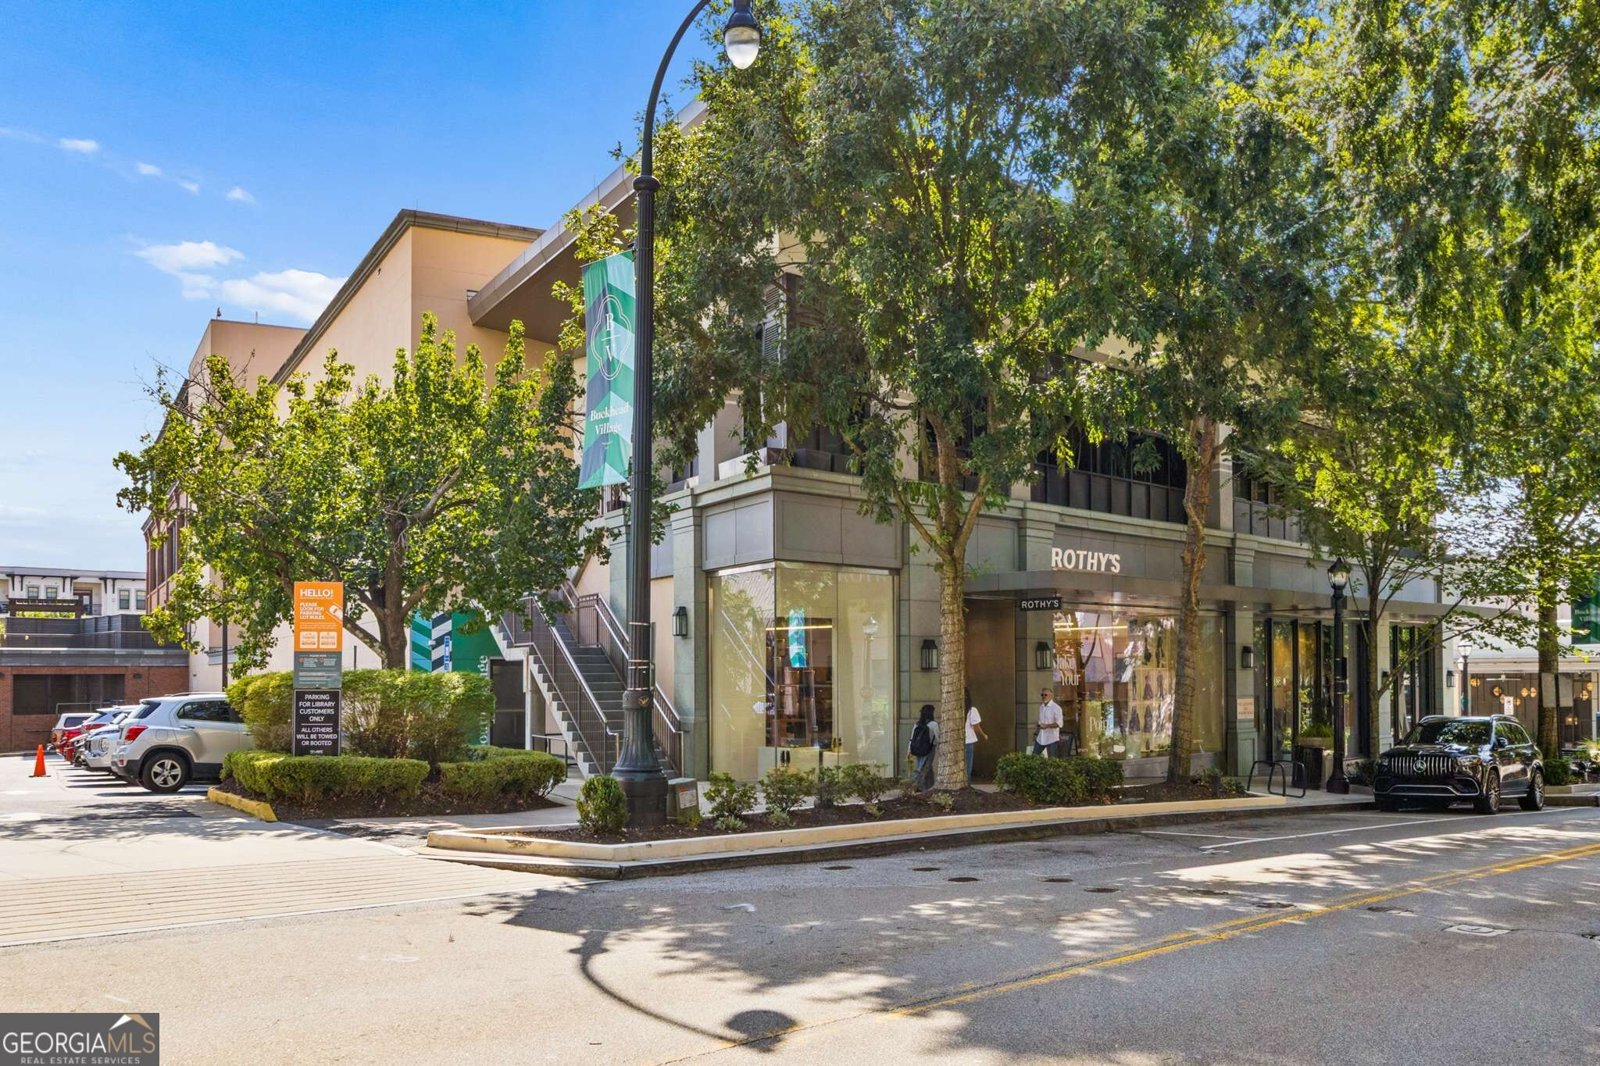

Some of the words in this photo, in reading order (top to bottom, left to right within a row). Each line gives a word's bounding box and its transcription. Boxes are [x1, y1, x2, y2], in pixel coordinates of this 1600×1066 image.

[590, 401, 629, 421] Buckhead
[595, 422, 623, 435] Village
[1051, 547, 1121, 574] ROTHY'S
[300, 588, 333, 596] HELLO!
[1021, 599, 1060, 610] ROTHY'S
[1060, 670, 1081, 686] Your
